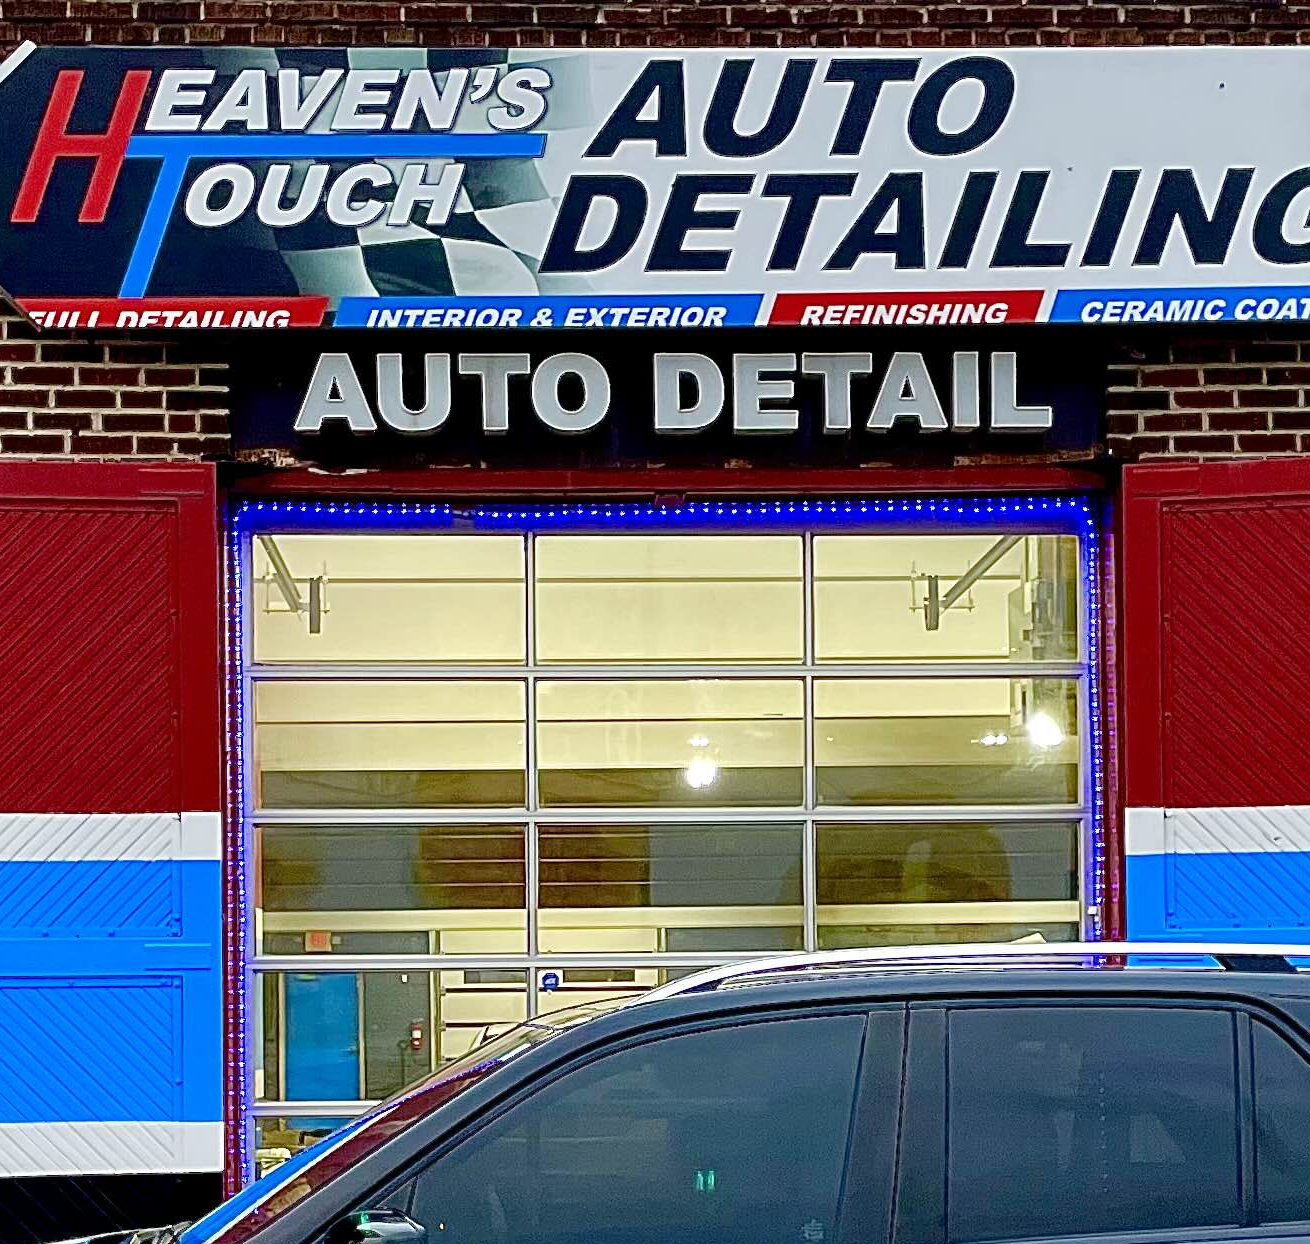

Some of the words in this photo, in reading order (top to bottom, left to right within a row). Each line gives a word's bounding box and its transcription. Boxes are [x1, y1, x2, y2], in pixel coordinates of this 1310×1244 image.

[583, 56, 1016, 158] AUTO
[11, 68, 553, 223] HEAVEN'S
[115, 309, 292, 328] DETAILING
[366, 308, 522, 328] INTERIOR
[530, 307, 553, 328] &
[563, 306, 728, 328] EXTERIOR
[800, 302, 1009, 326] REFINISHING
[1081, 299, 1227, 323] CERAMIC
[293, 352, 612, 432] AUTO
[653, 352, 1054, 431] DETAIL
